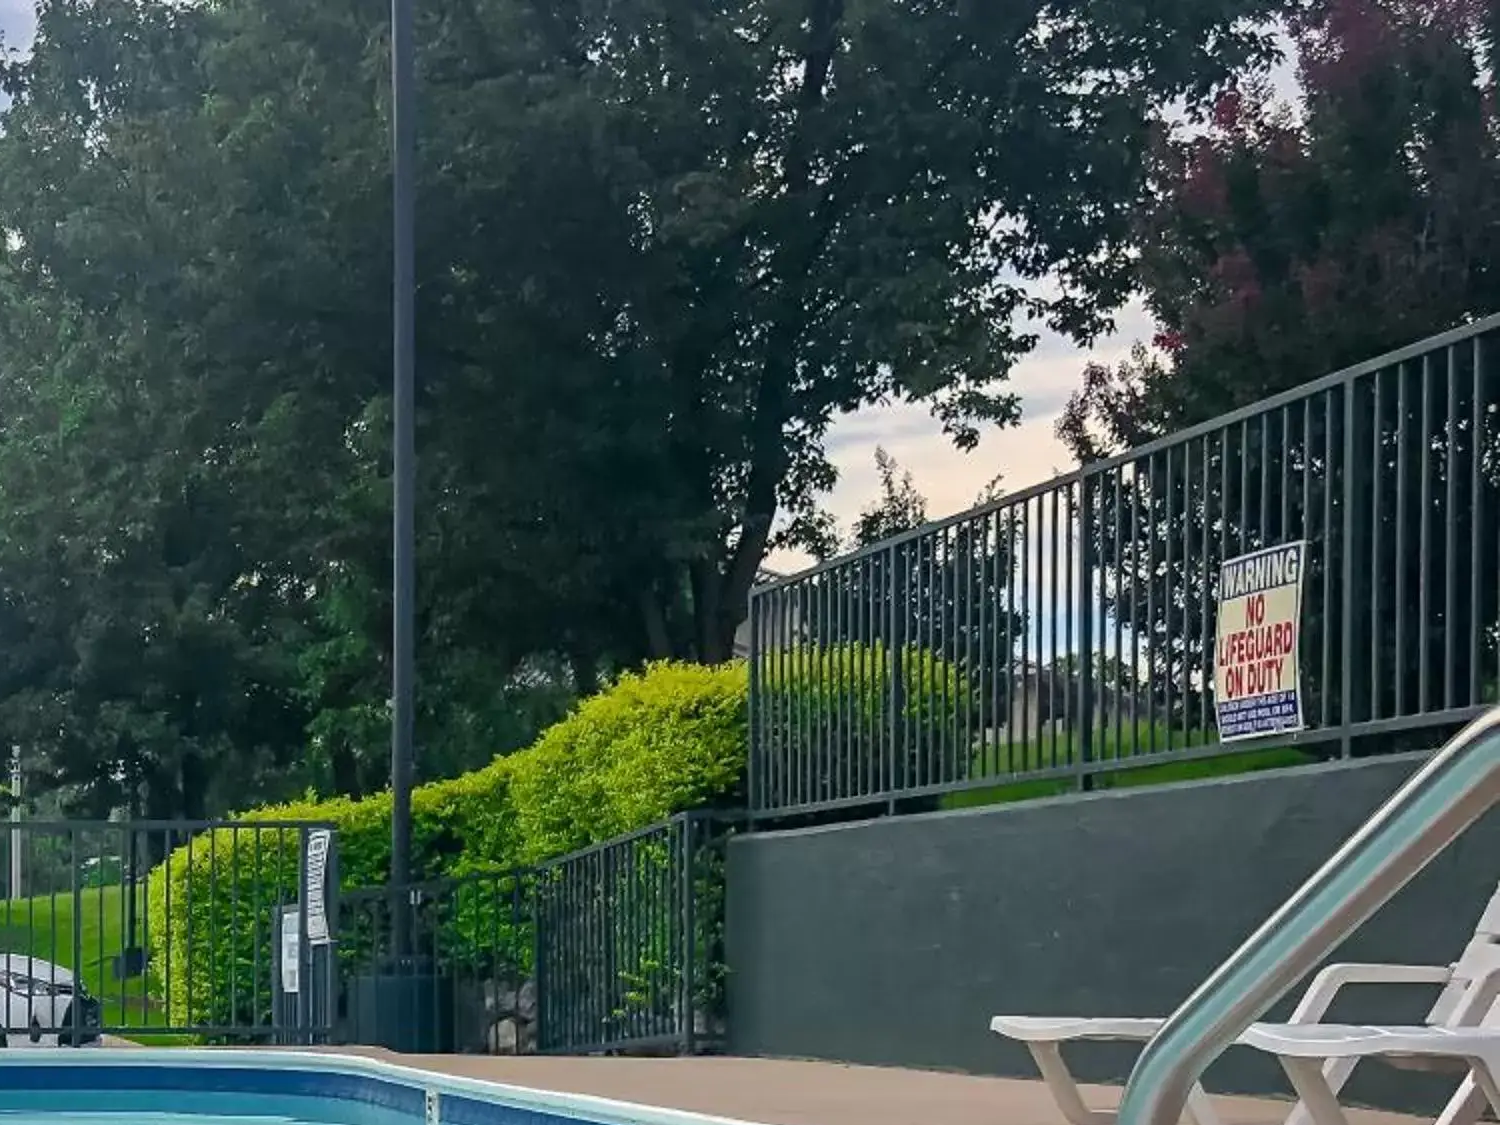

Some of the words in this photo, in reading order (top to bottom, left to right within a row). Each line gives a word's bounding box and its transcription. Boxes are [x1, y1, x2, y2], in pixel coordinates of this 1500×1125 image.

[1224, 548, 1297, 599] WARNING
[1246, 593, 1265, 628] NO
[1219, 621, 1292, 667] LIFEGUARD
[1226, 665, 1243, 698] ON
[1247, 658, 1283, 694] DUTY
